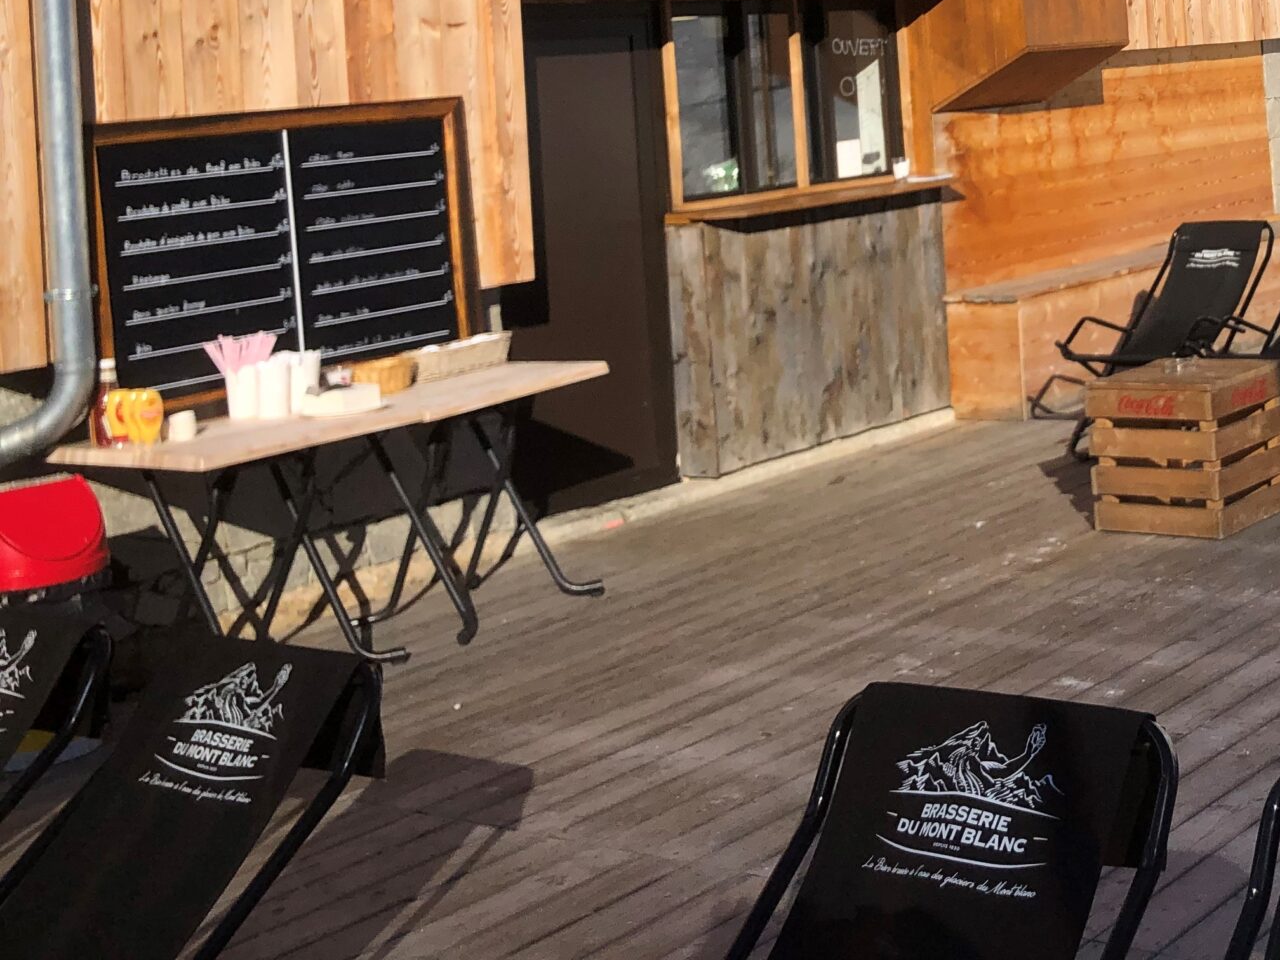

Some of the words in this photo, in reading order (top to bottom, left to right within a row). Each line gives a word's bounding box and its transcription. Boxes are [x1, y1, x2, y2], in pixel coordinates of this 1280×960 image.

[172, 741, 187, 755] DU
[186, 743, 222, 764] MONT
[218, 751, 258, 769] BLANC
[190, 729, 254, 753] BRASSERIE
[921, 803, 1012, 833] BRASSERIE
[897, 818, 921, 835] DU
[919, 821, 963, 841] MONT
[960, 828, 1028, 853] BLANC
